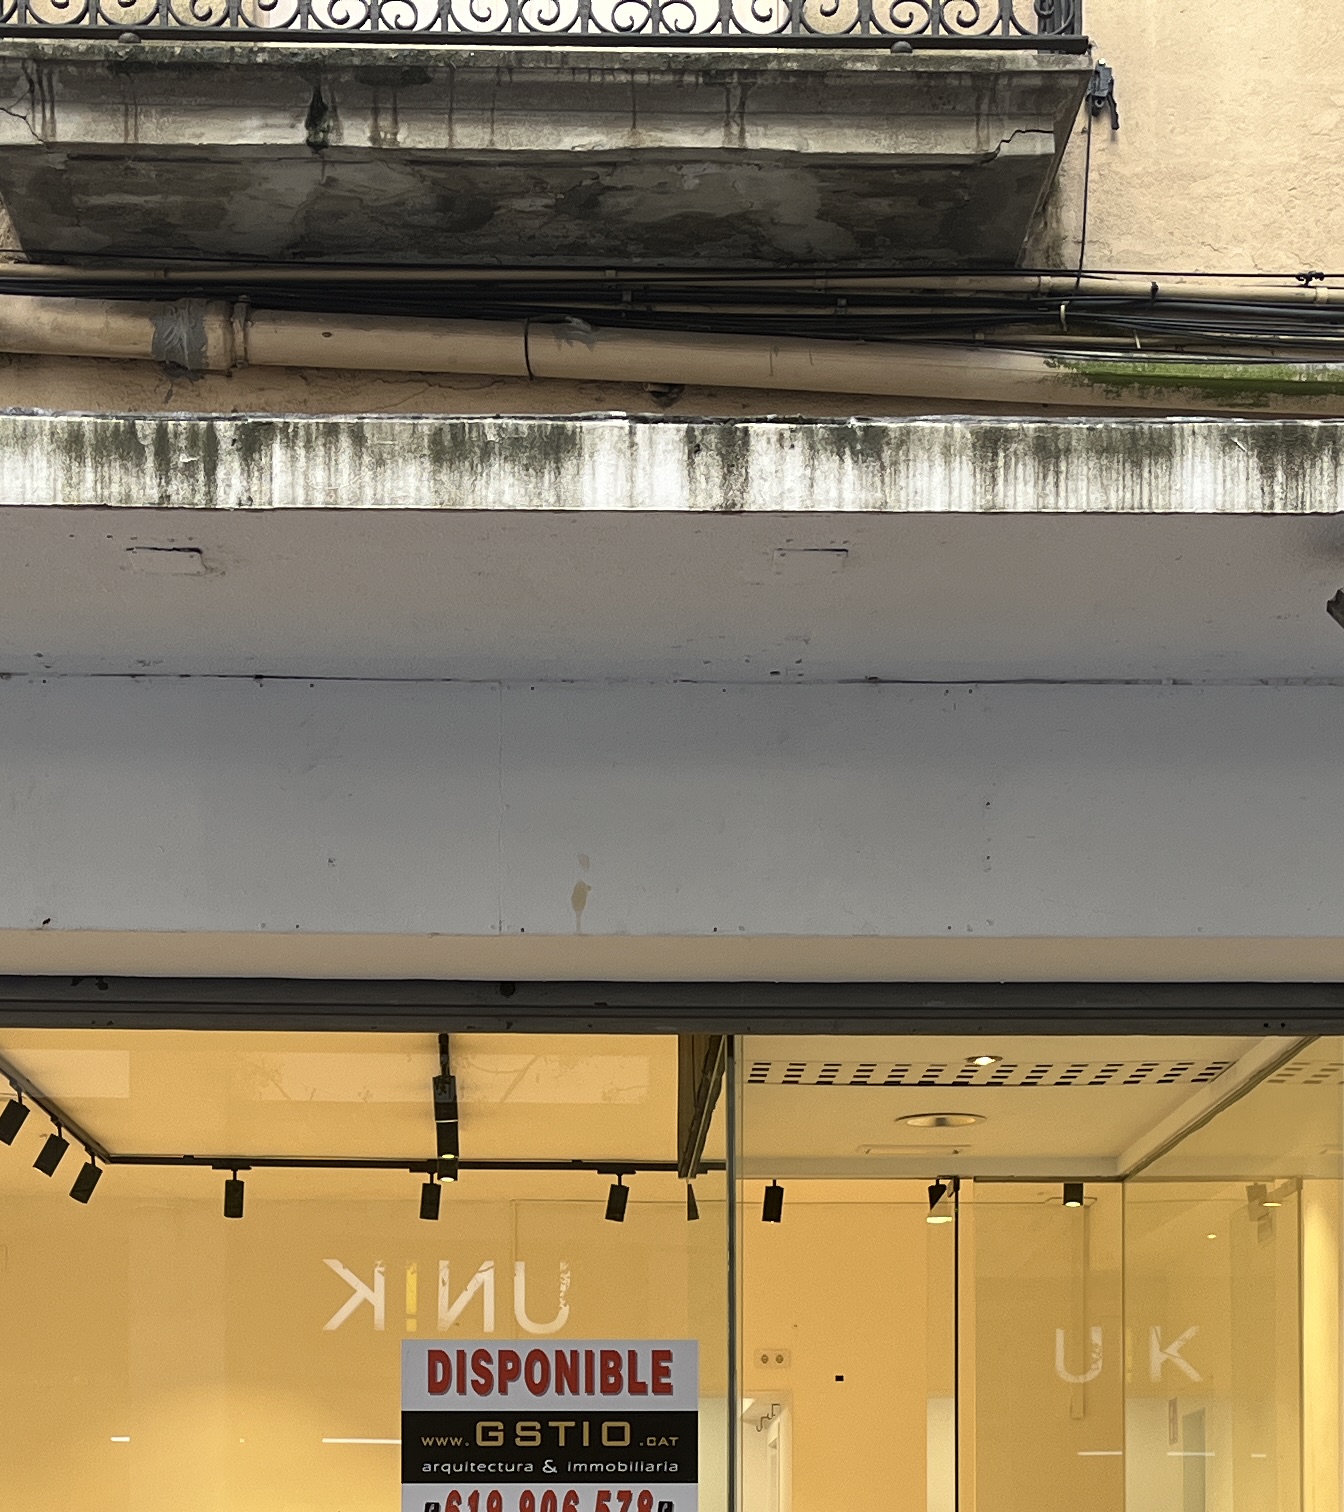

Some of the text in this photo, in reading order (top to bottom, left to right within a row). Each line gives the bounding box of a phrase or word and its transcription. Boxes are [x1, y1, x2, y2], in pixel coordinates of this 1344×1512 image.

[427, 1348, 674, 1397] DISPONIBLE
[421, 1459, 679, 1475] arquitectura & immobiliaria
